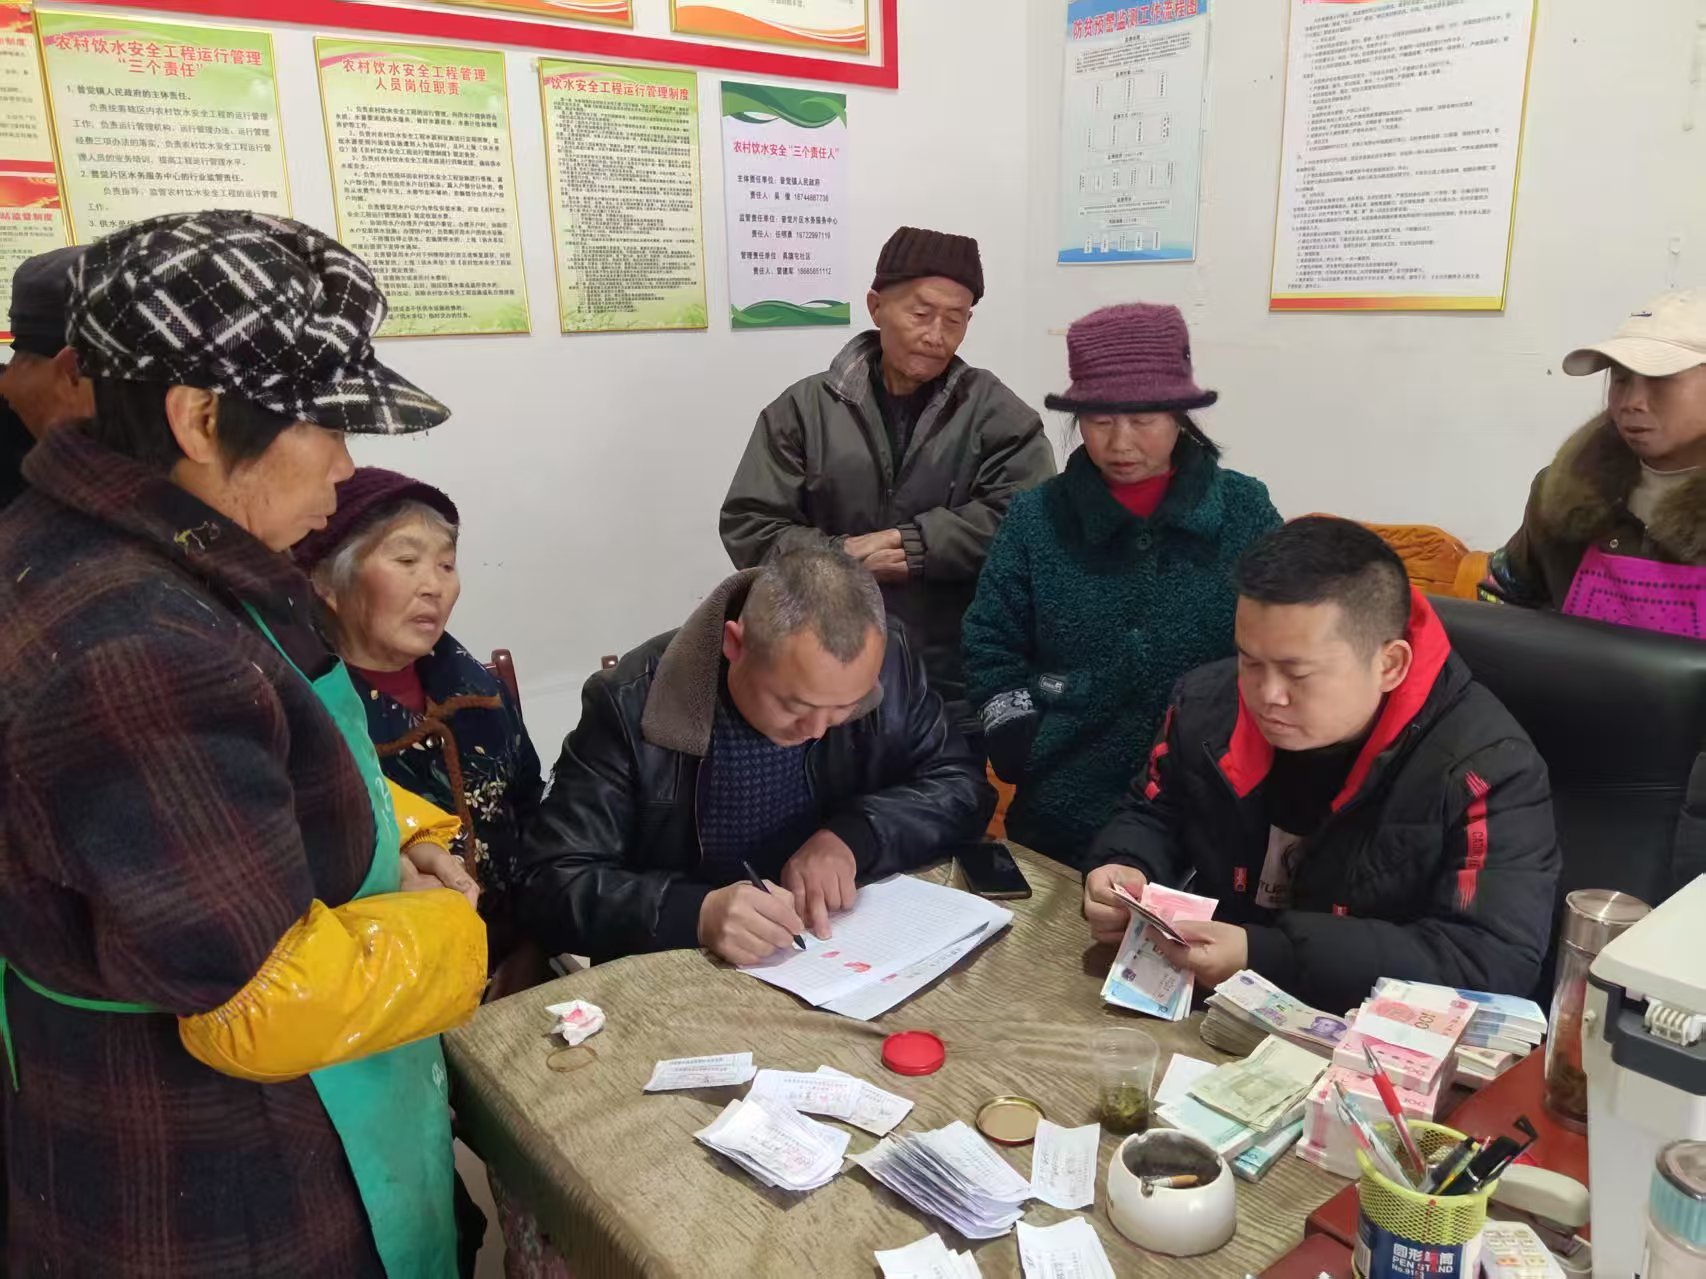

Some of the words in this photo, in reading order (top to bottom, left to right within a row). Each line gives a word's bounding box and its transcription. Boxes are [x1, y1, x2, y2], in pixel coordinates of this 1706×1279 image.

[53, 35, 263, 66] 农村饮水安全工程运行管理
[117, 57, 205, 78] “三个责任”
[343, 59, 487, 82] 农村饮水安全工程管理
[376, 77, 460, 95] 人员岗位职责
[551, 77, 689, 101] 饮水安全工程运行管理制度
[1391, 1254, 1415, 1269] PEN
